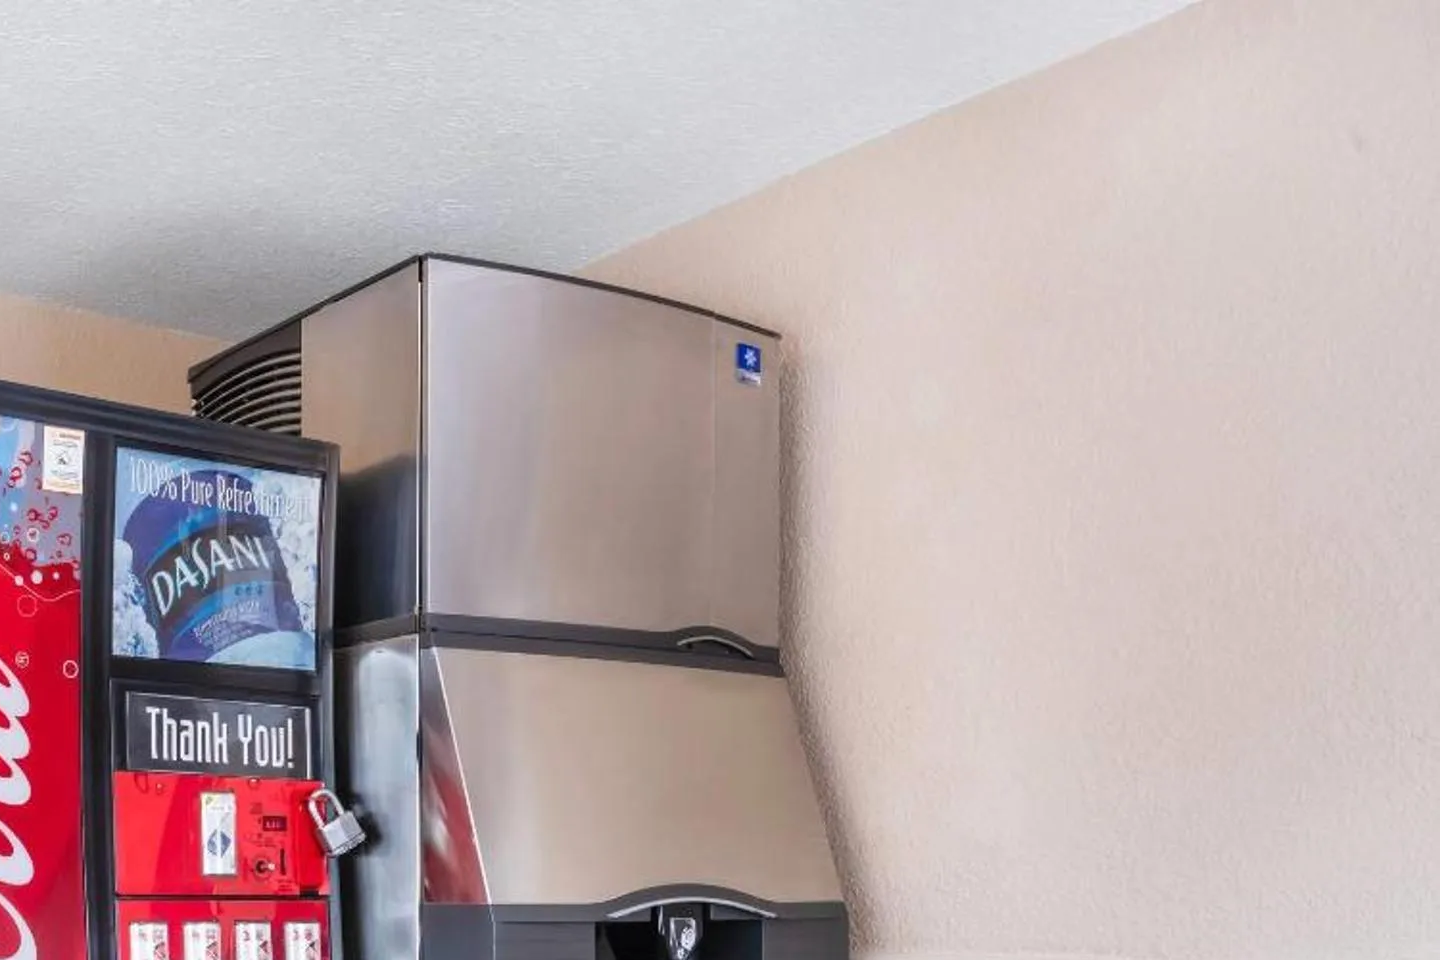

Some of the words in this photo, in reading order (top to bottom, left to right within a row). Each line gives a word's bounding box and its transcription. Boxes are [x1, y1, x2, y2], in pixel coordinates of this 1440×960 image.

[129, 456, 179, 501] 100%
[180, 468, 213, 508] Pure
[151, 534, 271, 617] DASANI
[145, 706, 229, 765] Thank
[237, 713, 295, 769] You!
